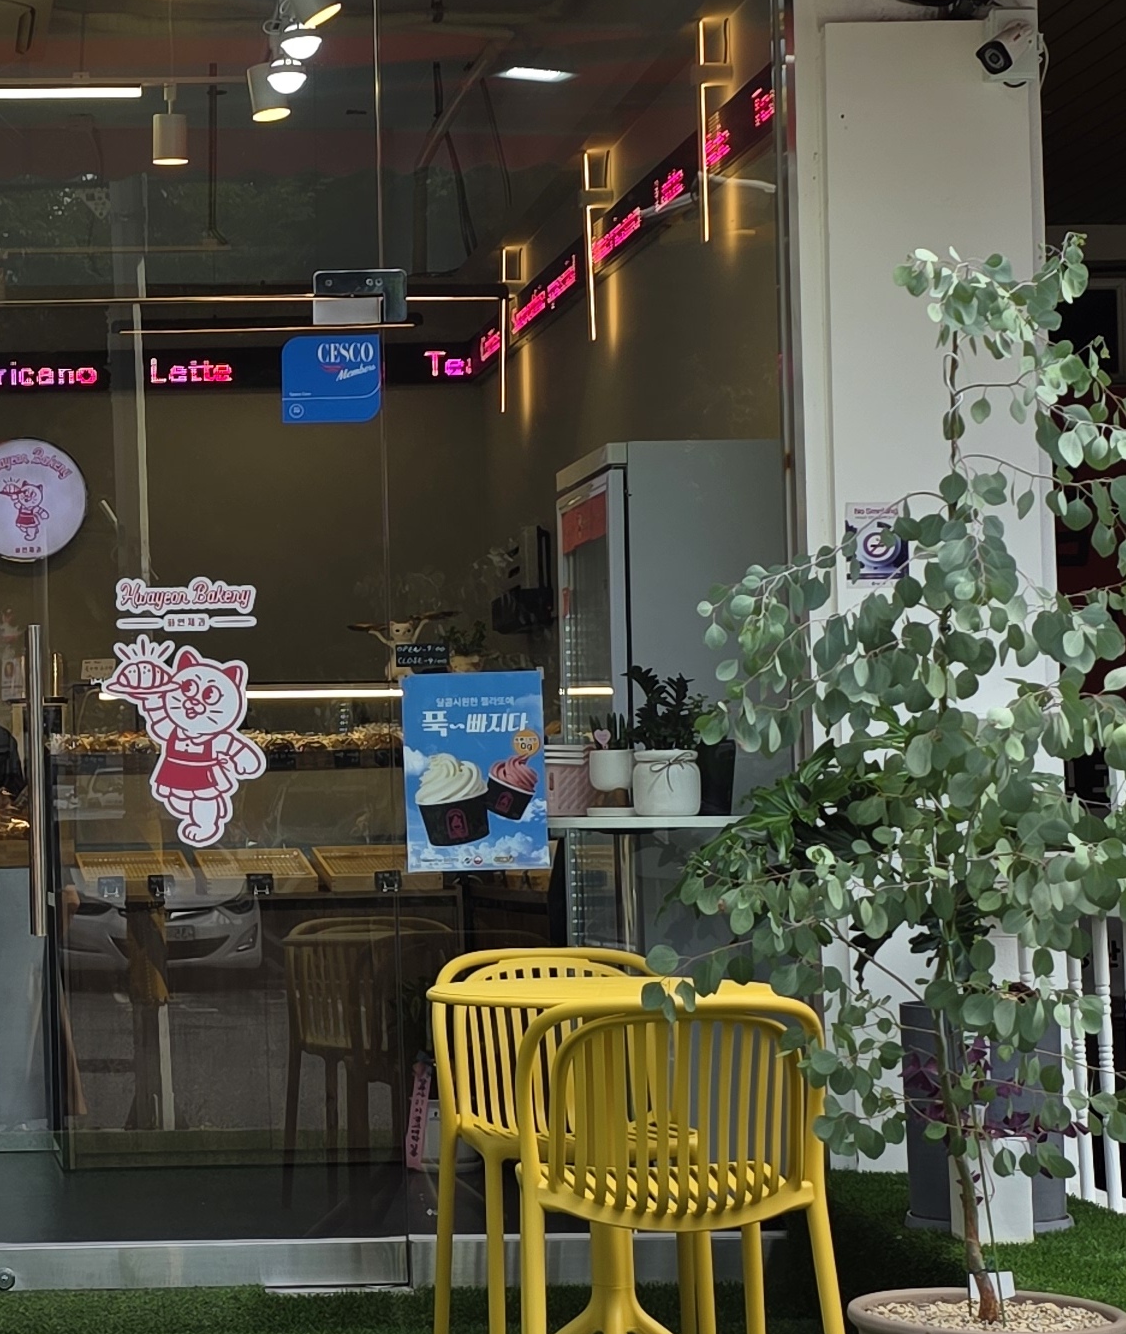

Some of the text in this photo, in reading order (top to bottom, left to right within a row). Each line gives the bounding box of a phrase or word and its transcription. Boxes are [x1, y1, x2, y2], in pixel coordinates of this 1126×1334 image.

[317, 341, 375, 364] CESCO
[120, 580, 252, 611] Hwayeon Bakery
